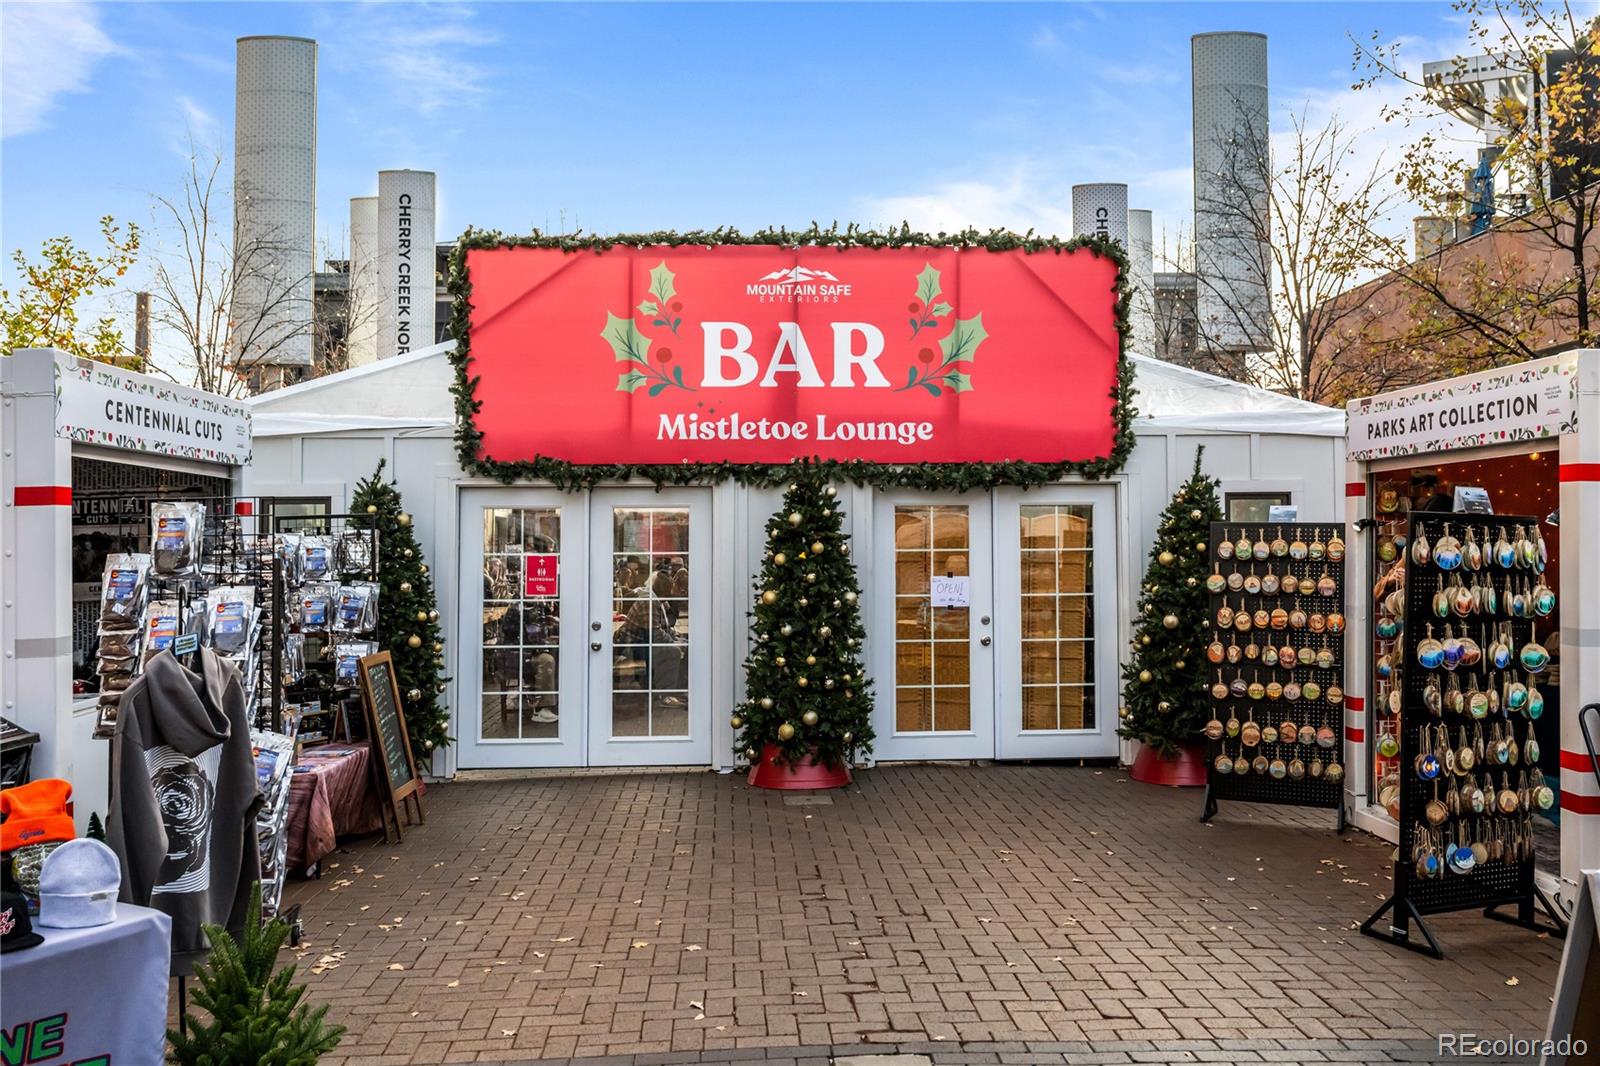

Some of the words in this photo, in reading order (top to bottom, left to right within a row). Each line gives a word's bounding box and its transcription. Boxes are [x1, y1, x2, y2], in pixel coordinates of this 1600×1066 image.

[398, 193, 412, 261] CHERRY
[397, 262, 411, 316] CREEK
[746, 284, 816, 296] MOUNTAIN
[819, 284, 852, 296] SAFE
[759, 295, 839, 303] EXTERIORS
[700, 321, 891, 388] BAR
[105, 399, 191, 436] CENTENNIAL
[194, 418, 223, 442] CUTS
[656, 412, 808, 441] Mistletoe
[815, 414, 934, 446] Lounge
[1367, 417, 1406, 440] PARKS
[1409, 412, 1434, 434] ART
[1438, 393, 1538, 428] COLLECTION
[86, 515, 110, 524] CUTS
